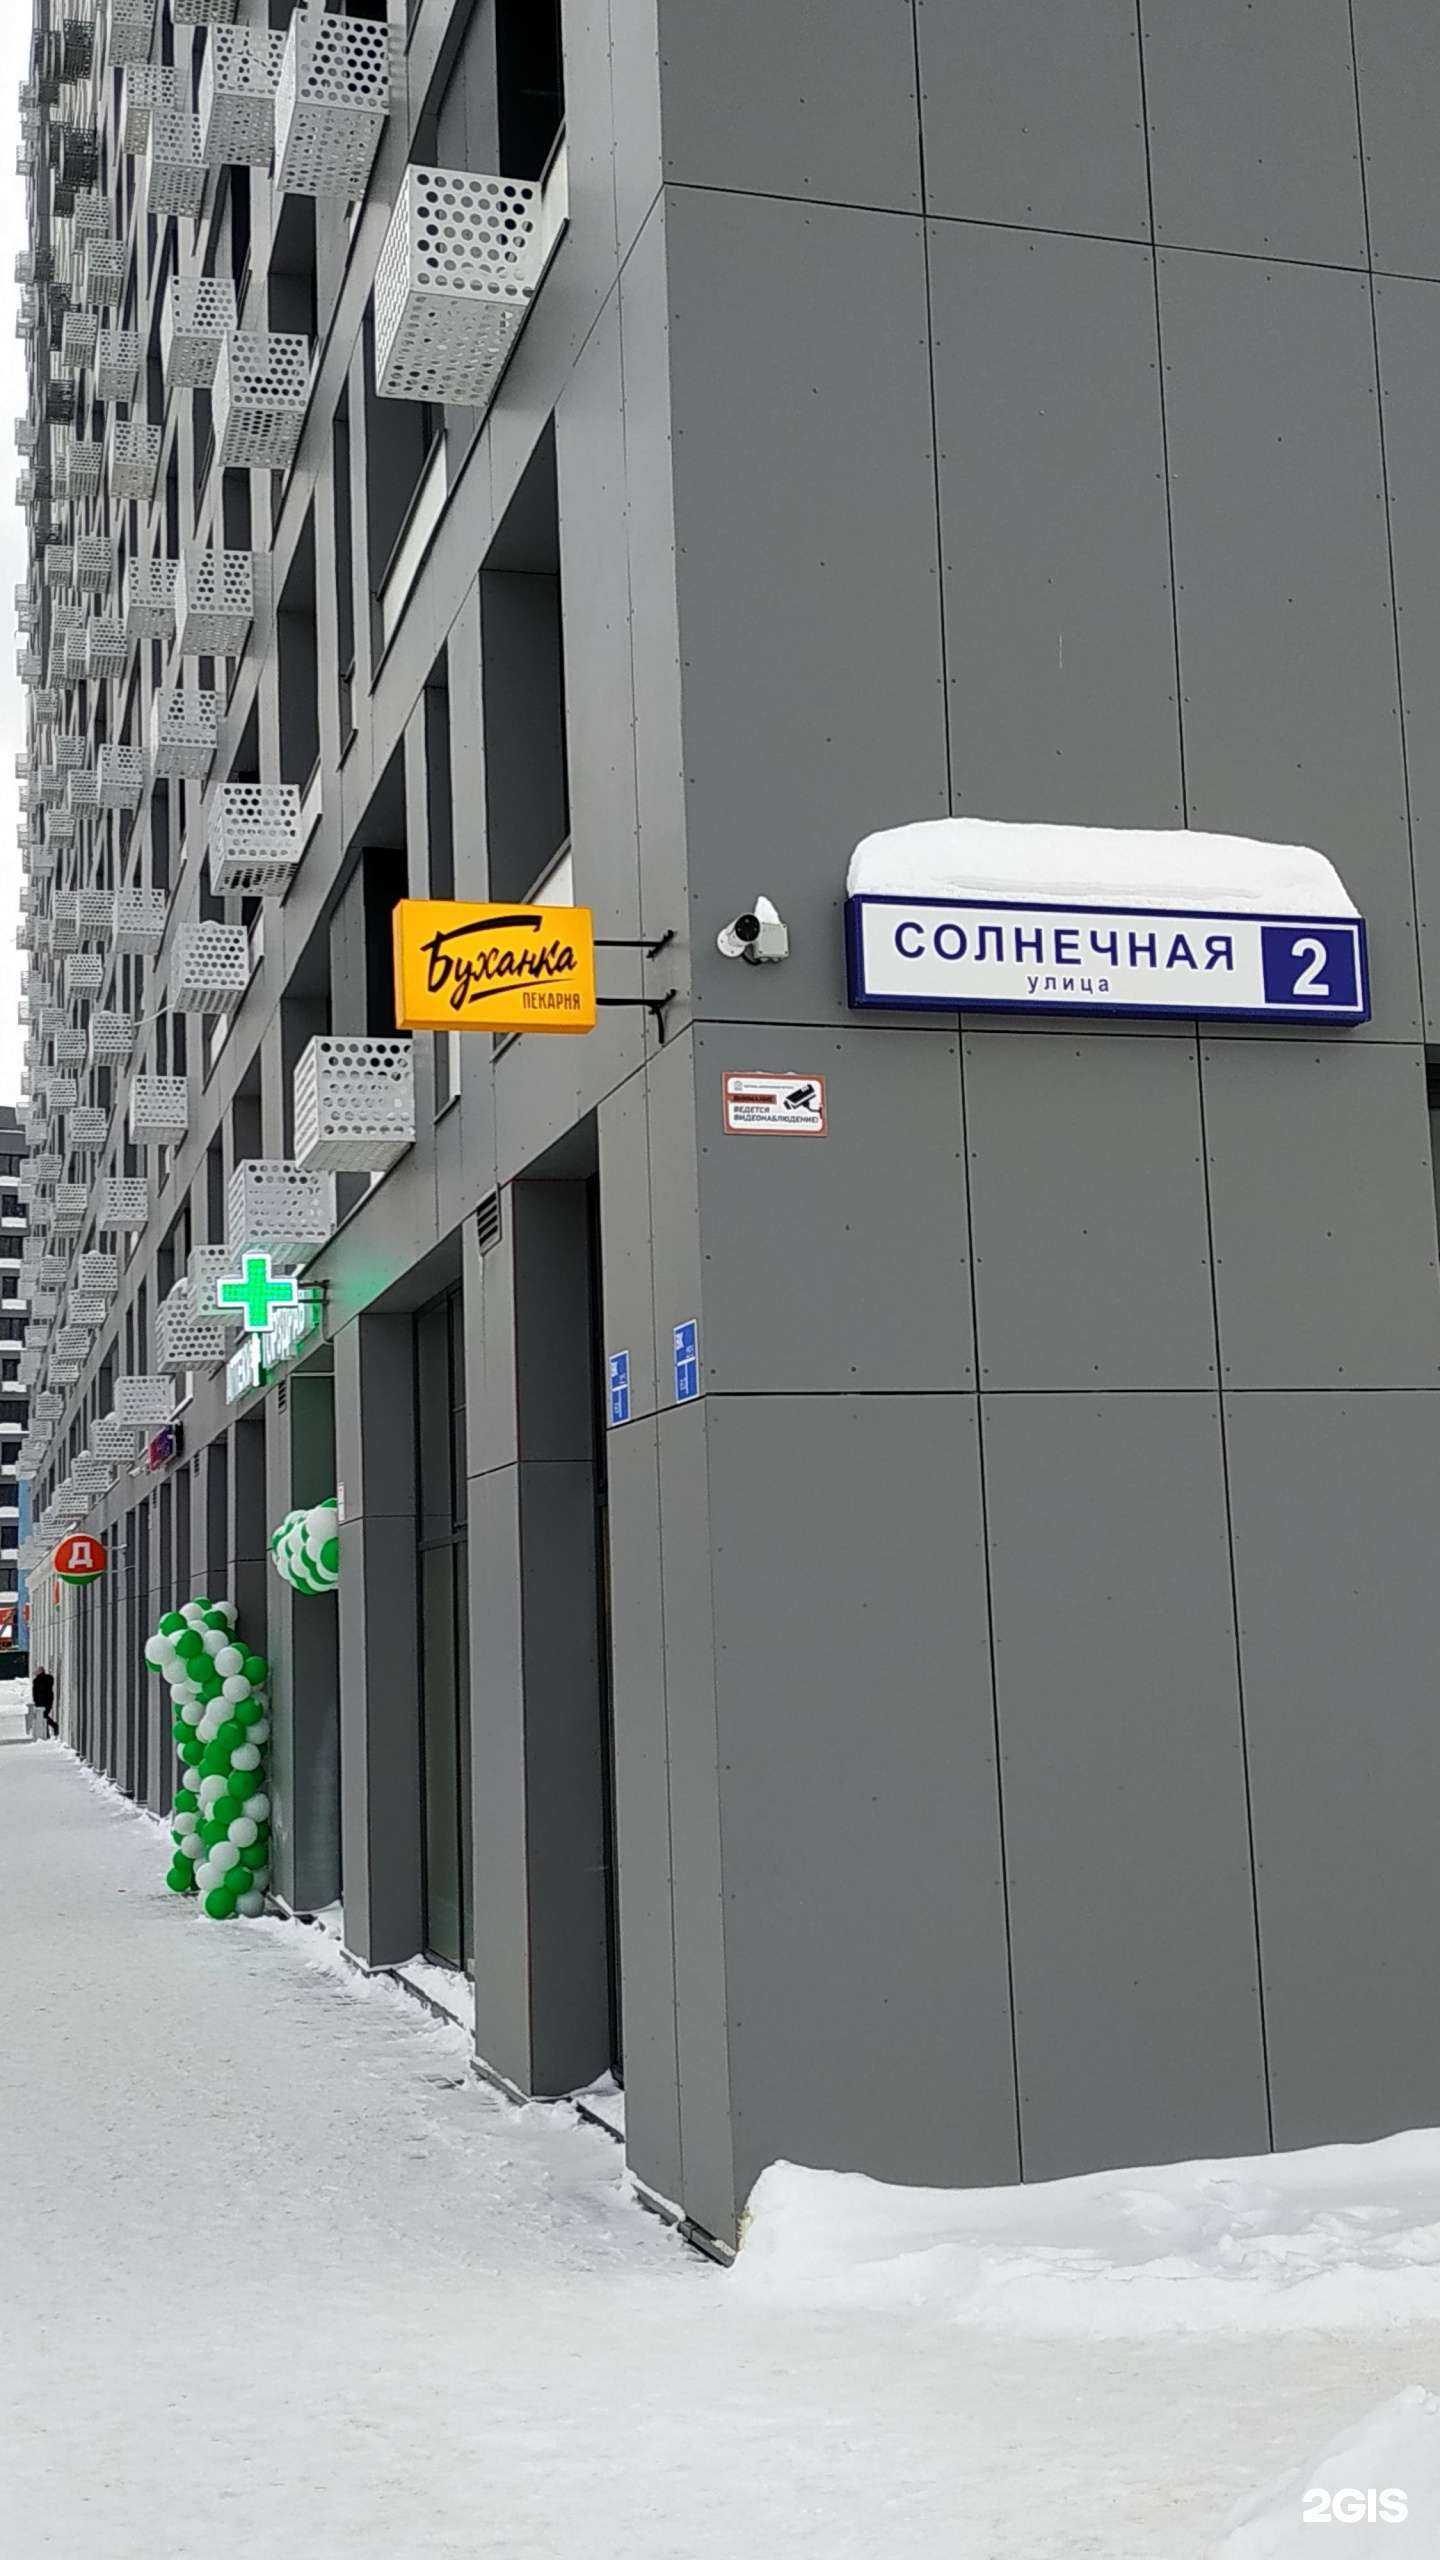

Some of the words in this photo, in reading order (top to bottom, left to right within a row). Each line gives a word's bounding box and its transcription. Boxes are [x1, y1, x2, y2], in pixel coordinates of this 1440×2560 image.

[420, 915, 578, 1011] Буханка
[894, 921, 1236, 971] СОЛНЕЧНАЯ
[1290, 938, 1331, 997] 2
[1026, 973, 1111, 994] улица
[523, 992, 581, 1010] ПЕКАРНЯ
[68, 1541, 94, 1569] Д
